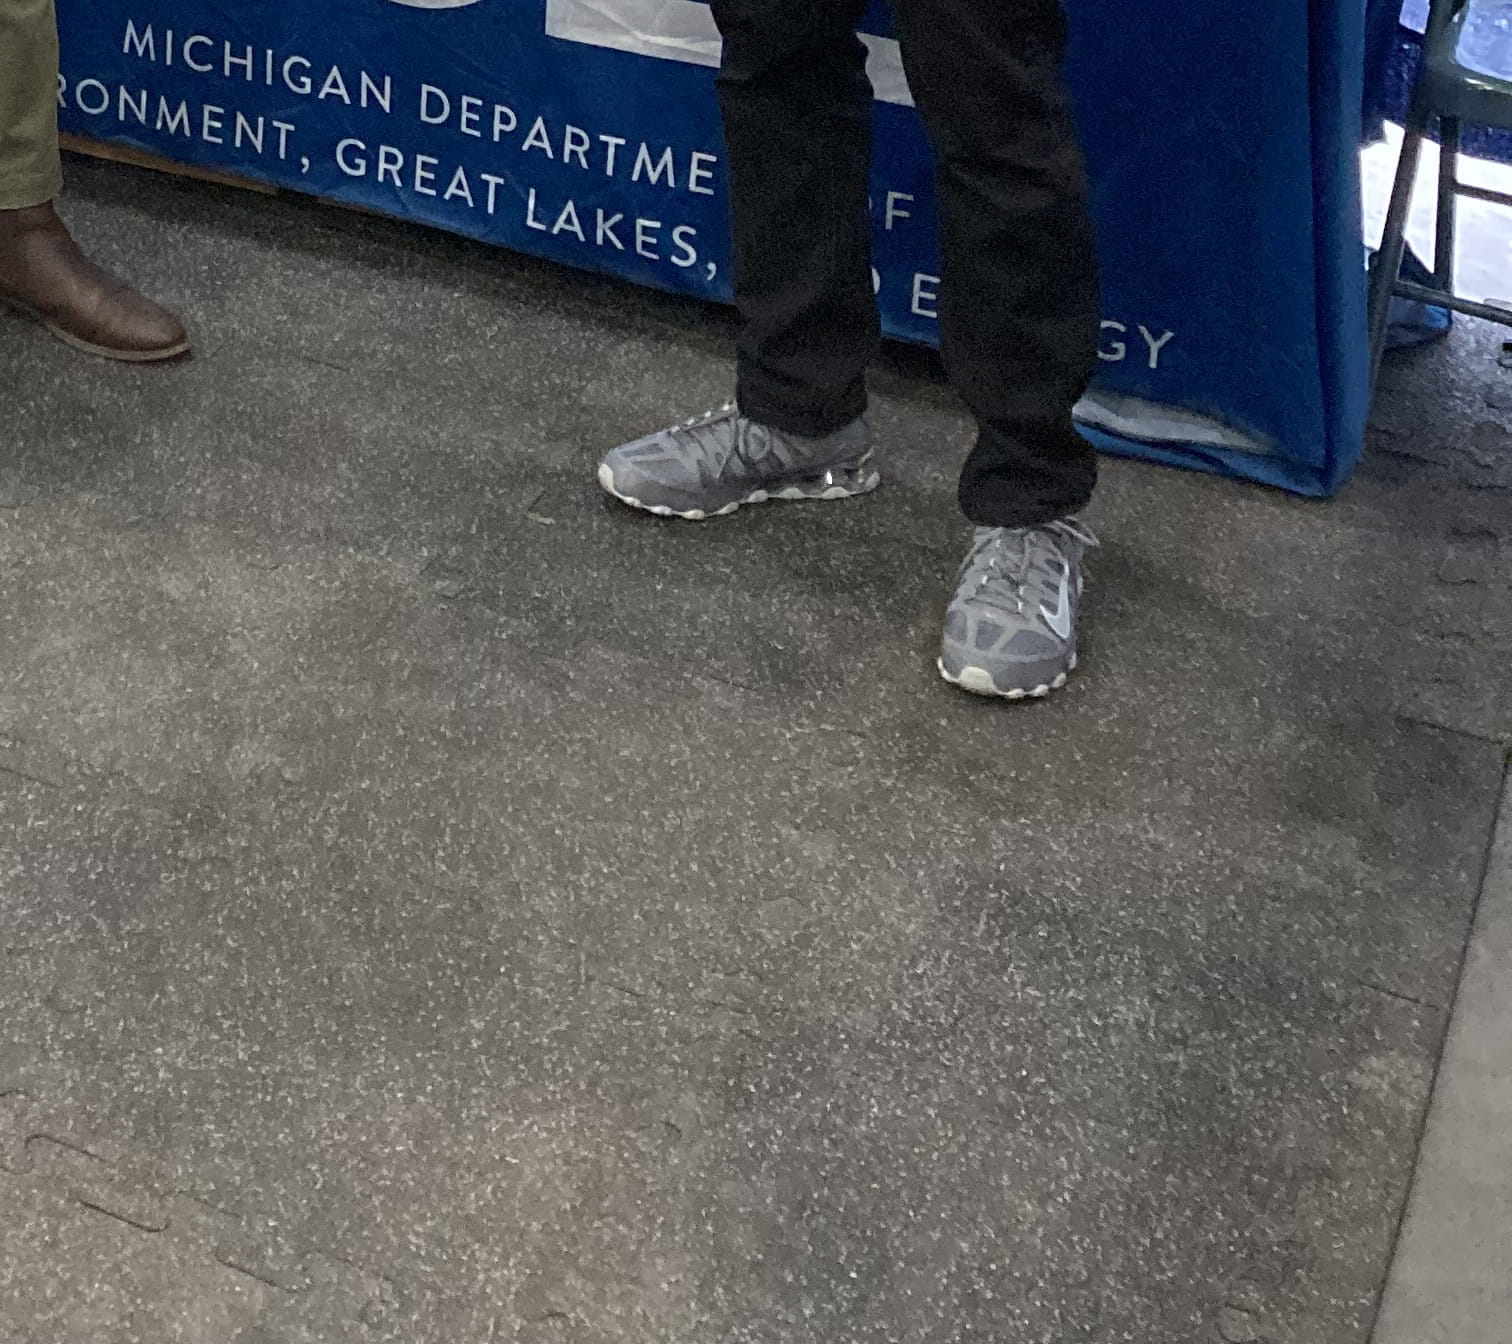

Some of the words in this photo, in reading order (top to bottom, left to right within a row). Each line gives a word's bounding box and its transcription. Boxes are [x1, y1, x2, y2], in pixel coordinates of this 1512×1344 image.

[122, 19, 391, 113] MICHIGAN
[420, 83, 717, 196] DEPARTME
[335, 137, 505, 214] GREAT
[527, 188, 718, 281] LAKES,
